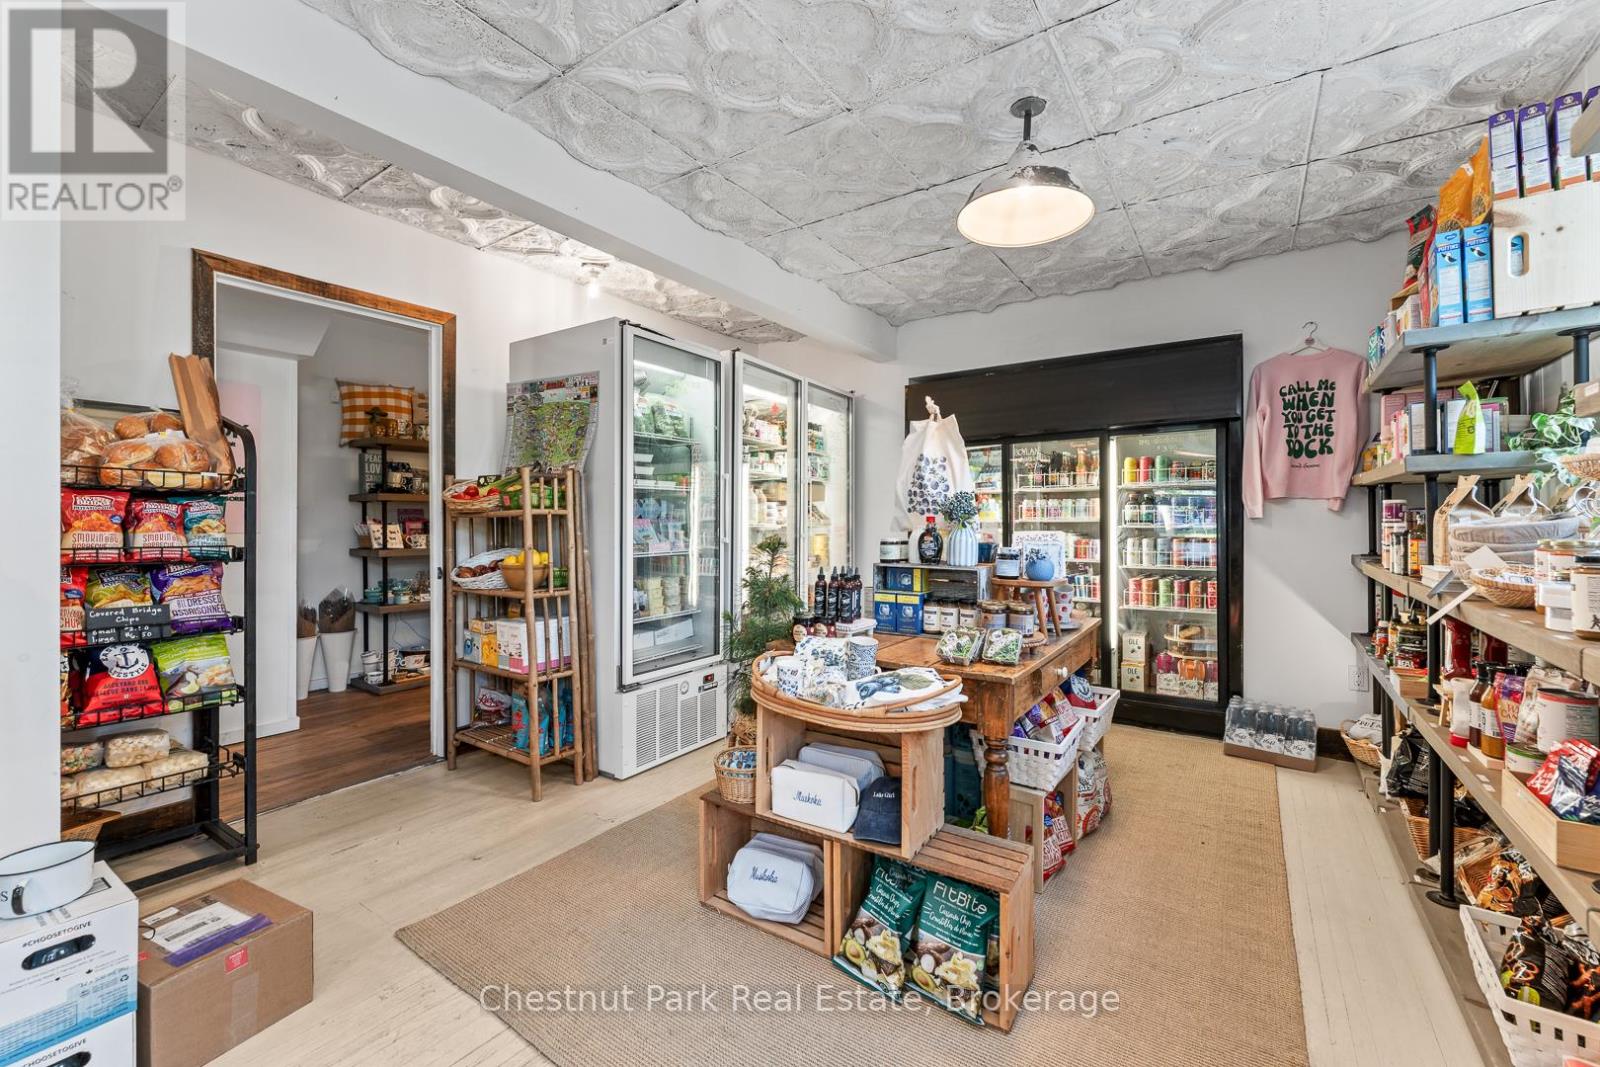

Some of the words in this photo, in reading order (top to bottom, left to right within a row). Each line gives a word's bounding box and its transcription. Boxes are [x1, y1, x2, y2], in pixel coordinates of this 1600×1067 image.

[1279, 381, 1315, 397] CALL
[1281, 391, 1335, 412] WHEN
[1281, 410, 1303, 424] YOU
[1305, 407, 1336, 423] GET
[1283, 423, 1299, 439] TO
[1300, 423, 1335, 439] THE
[1285, 438, 1334, 459] DOCK
[89, 608, 125, 618] Covered
[132, 606, 162, 616] Bridge
[793, 789, 822, 807] Muskoka
[750, 866, 779, 884] Muskoka
[21, 920, 93, 948] #CHOOSETOGIVE
